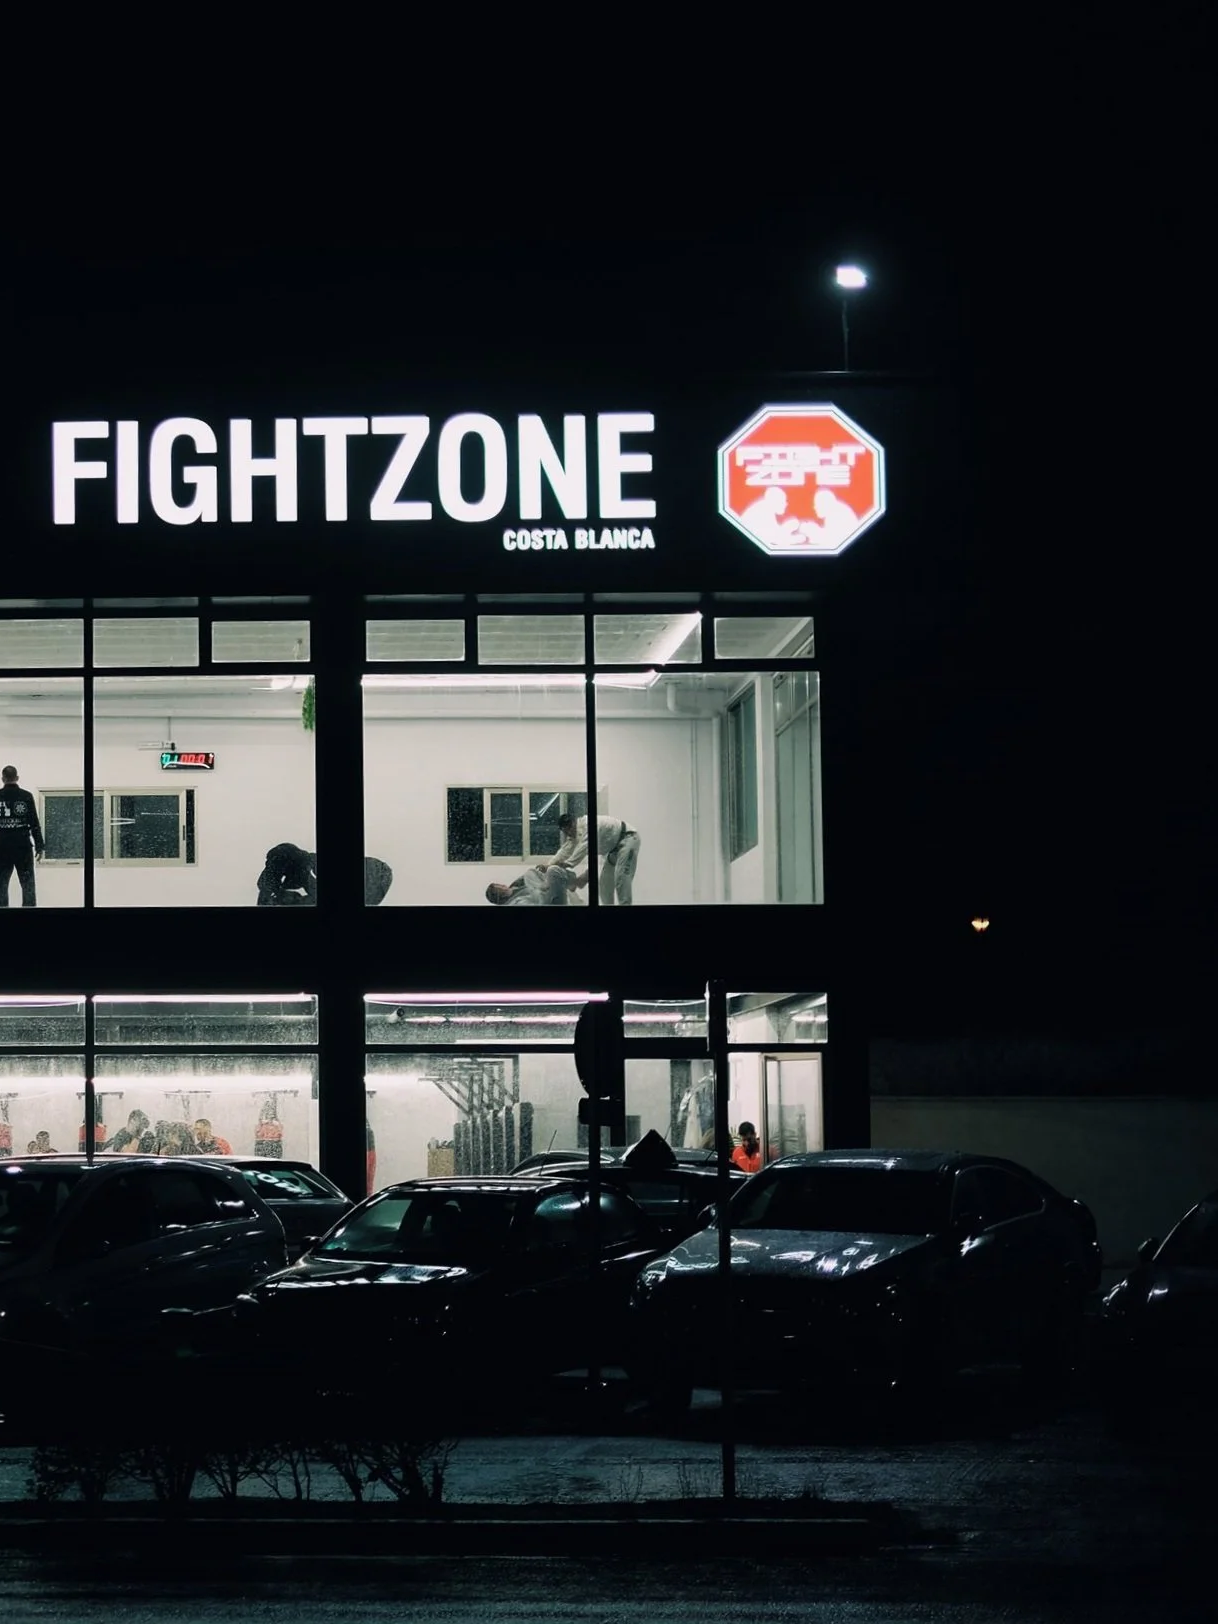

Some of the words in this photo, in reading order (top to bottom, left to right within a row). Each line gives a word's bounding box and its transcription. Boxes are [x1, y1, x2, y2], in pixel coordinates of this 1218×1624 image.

[51, 411, 658, 527] FIGHTZONE
[502, 527, 569, 550] COSTA
[574, 526, 656, 549] BLANCA
